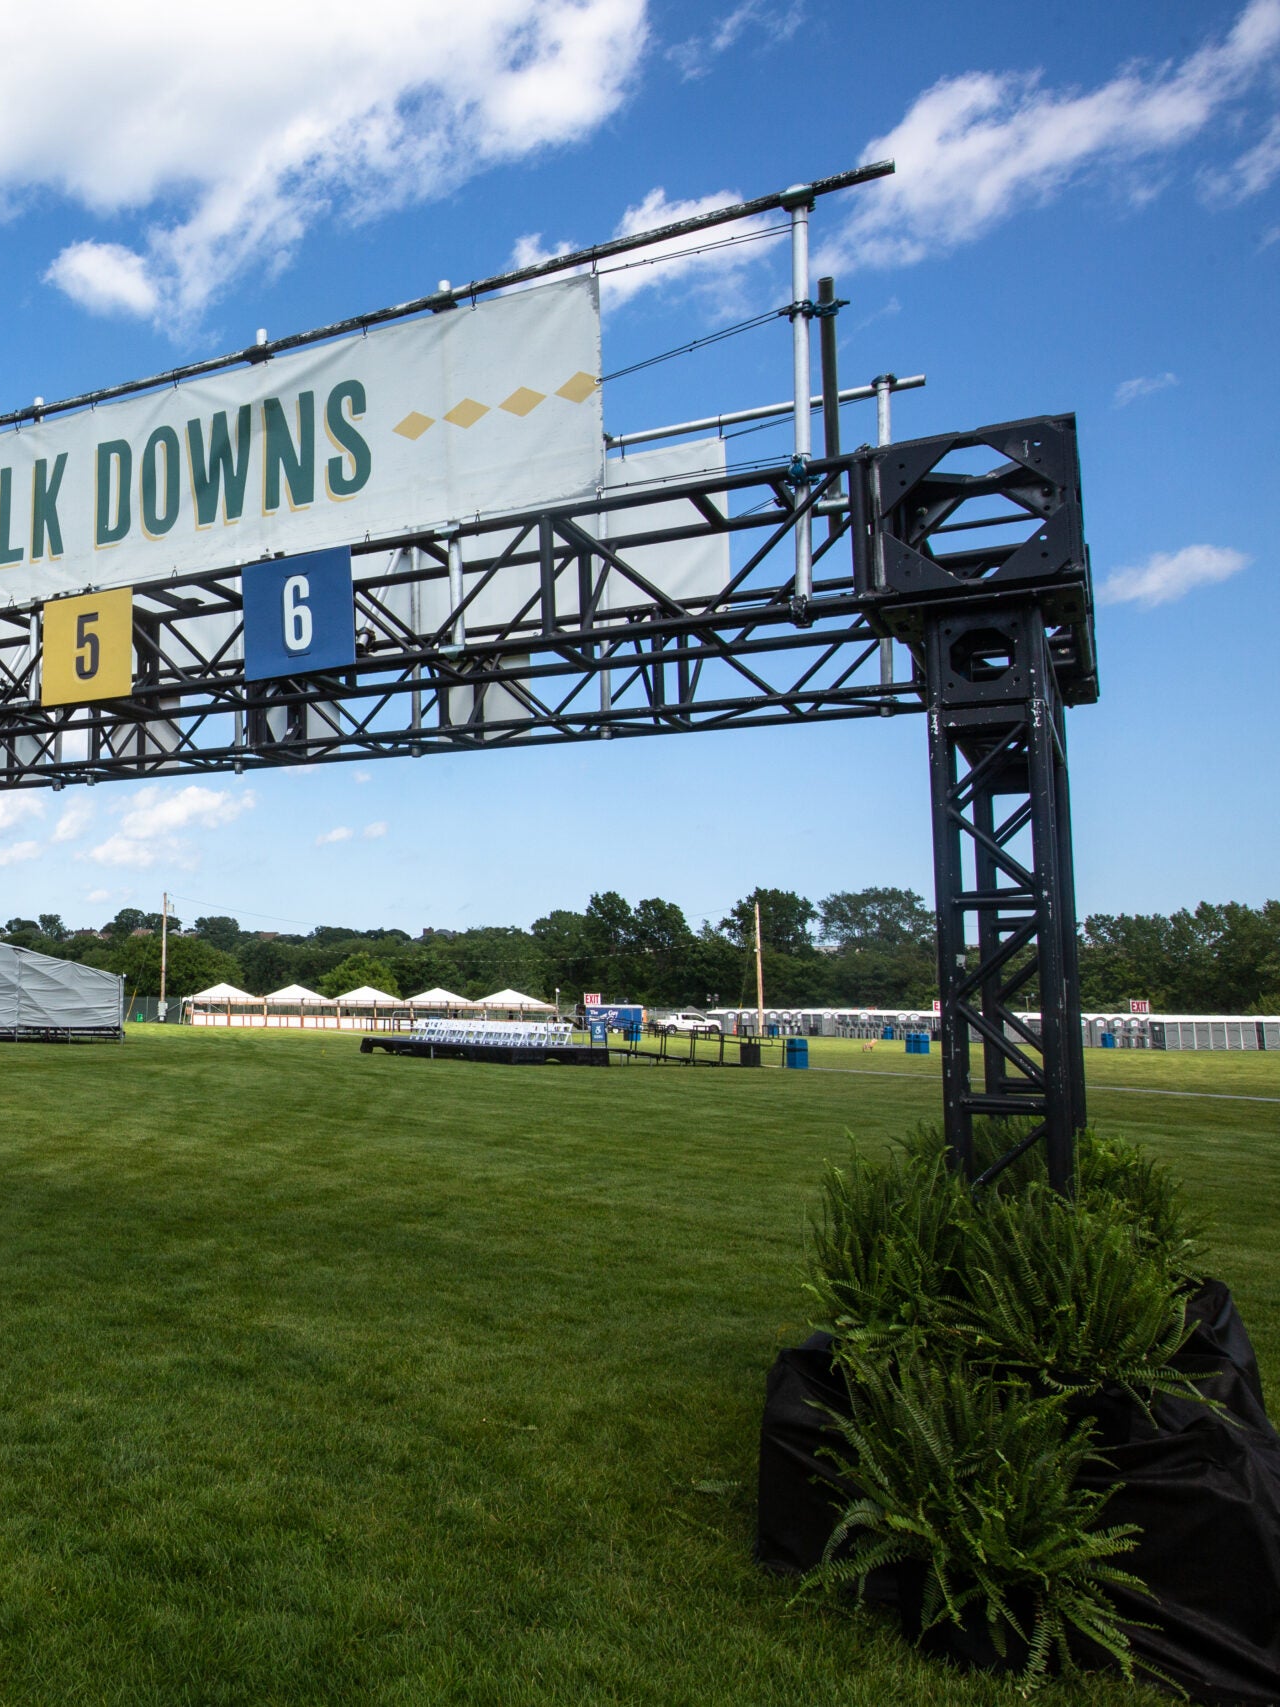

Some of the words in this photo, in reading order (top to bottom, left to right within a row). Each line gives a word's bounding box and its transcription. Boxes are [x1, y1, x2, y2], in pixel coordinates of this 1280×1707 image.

[93, 379, 372, 550] DOWNS
[74, 611, 100, 683] 5
[283, 572, 314, 656] 6
[585, 995, 599, 1004] EXIT
[1131, 1002, 1147, 1012] EXIT
